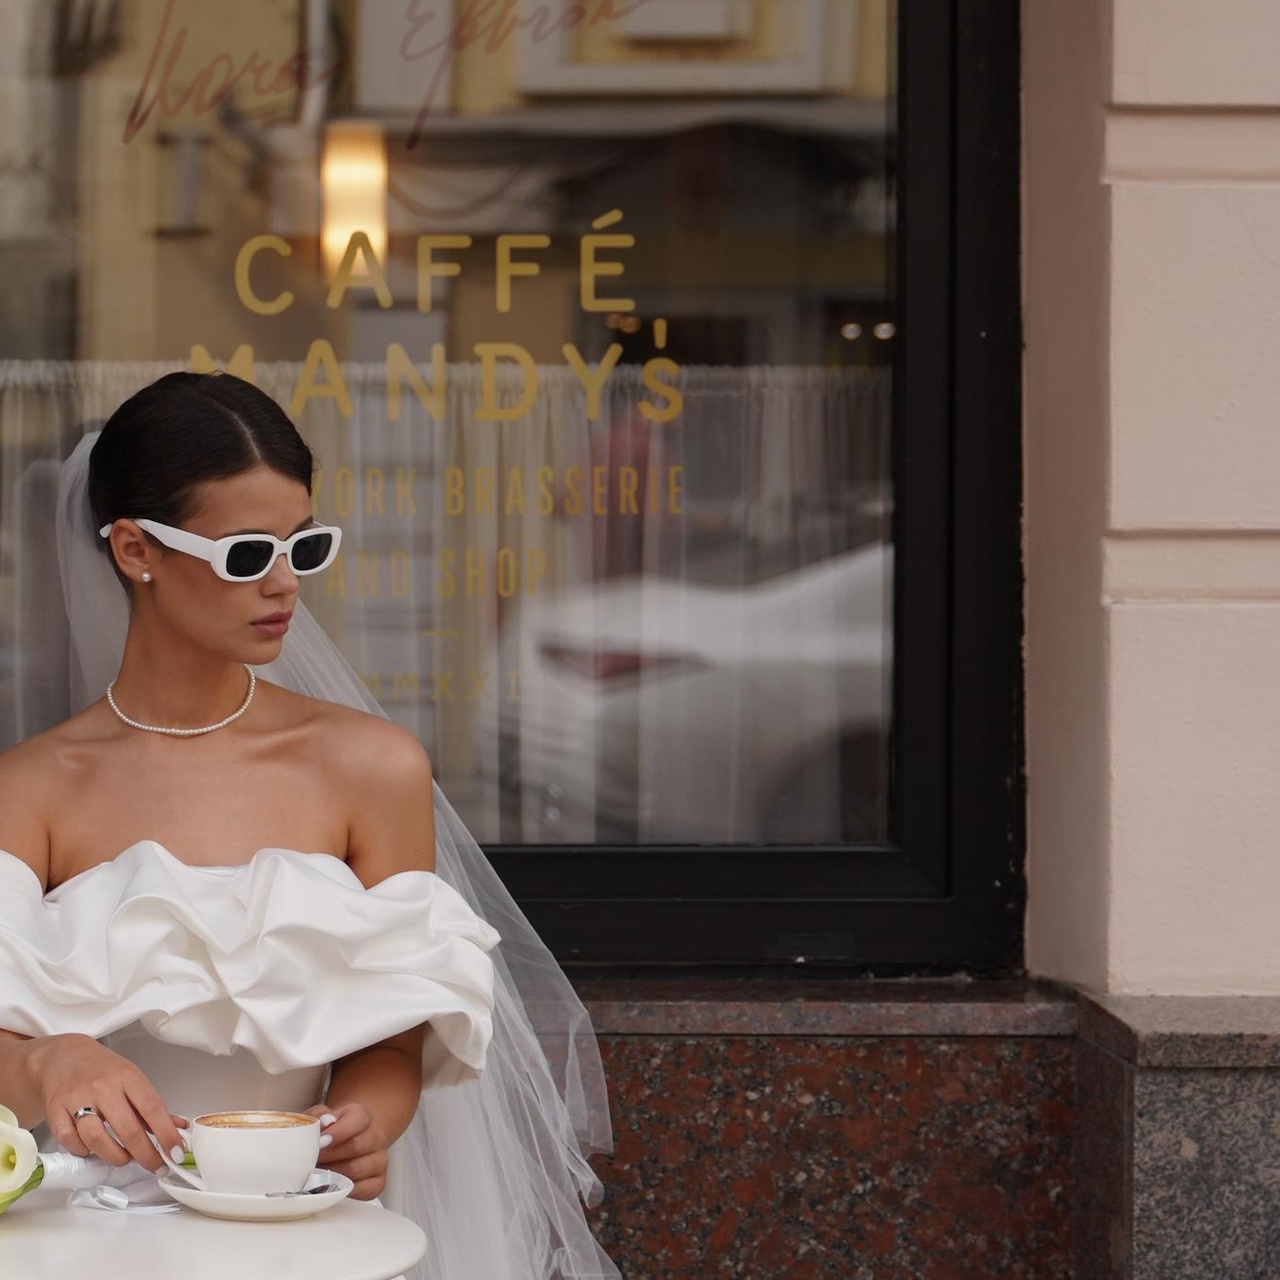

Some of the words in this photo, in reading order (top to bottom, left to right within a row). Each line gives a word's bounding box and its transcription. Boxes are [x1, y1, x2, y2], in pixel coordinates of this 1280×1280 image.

[234, 209, 635, 315] CAFFÉ
[446, 465, 686, 516] BRASSERIE
[326, 549, 409, 599] AND
[437, 548, 547, 598] SHOP
